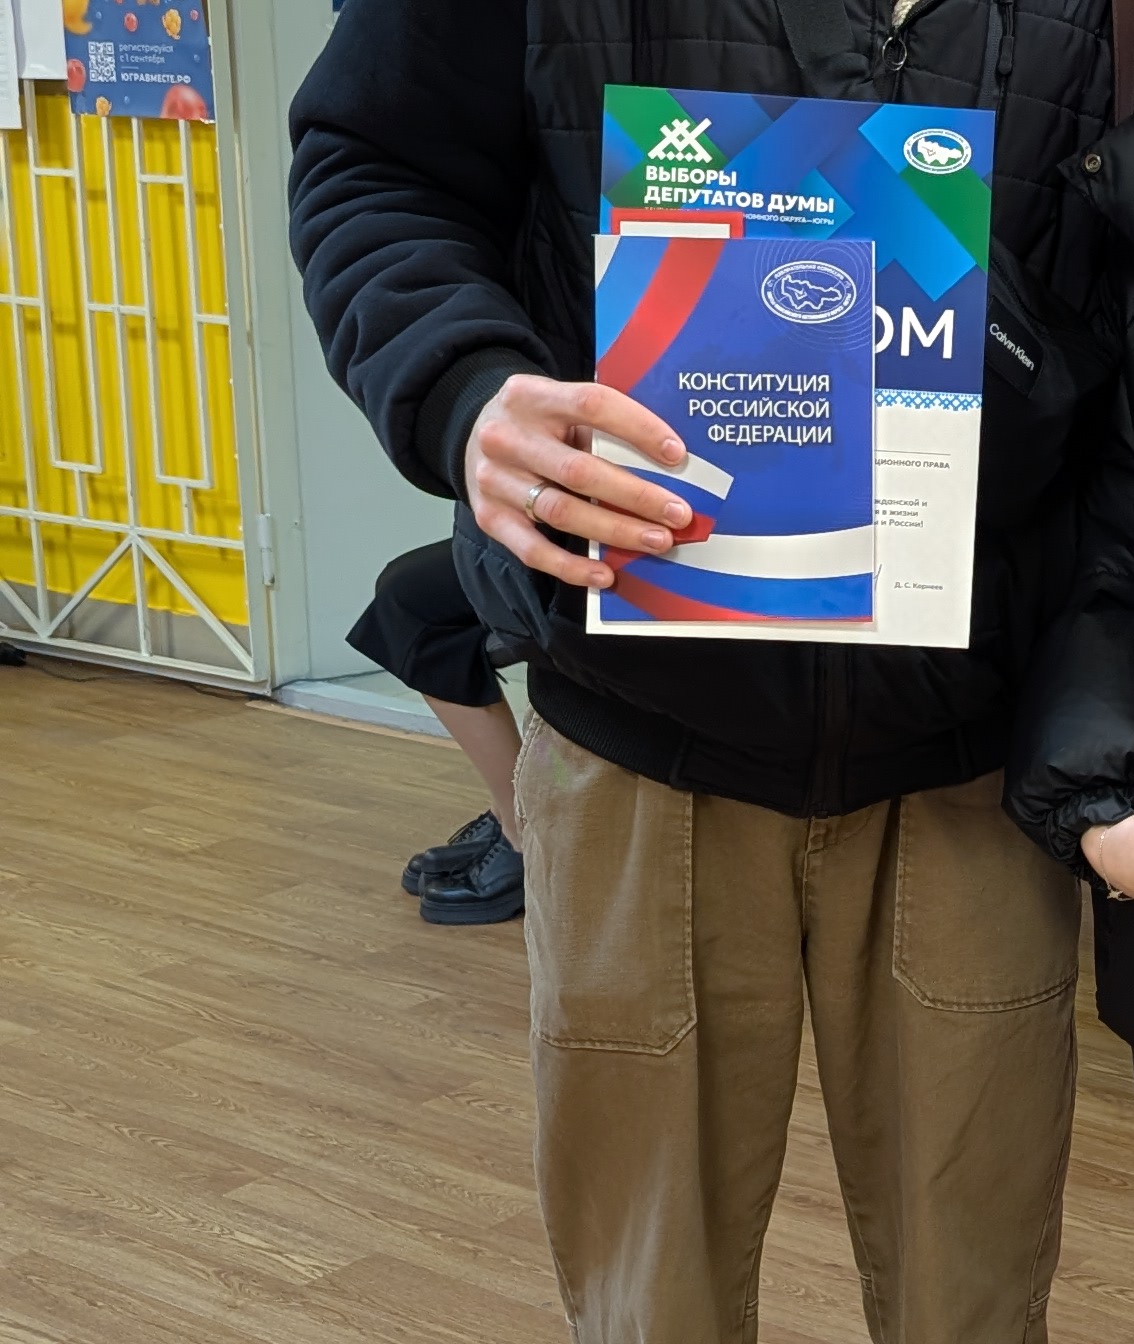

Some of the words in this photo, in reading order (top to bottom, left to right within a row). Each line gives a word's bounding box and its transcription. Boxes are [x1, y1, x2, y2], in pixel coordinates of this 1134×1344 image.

[121, 72, 192, 84] ЮГРАВМЕСТЕ.РФ
[645, 165, 737, 186] ВЫБОРЫ
[644, 186, 764, 208] ДЕПУТАТОВ
[767, 194, 835, 213] ДУМЫ
[990, 323, 1015, 353] Calvin
[1015, 346, 1035, 371] Klein
[678, 372, 830, 395] КОНСТИТУЦИЯ
[689, 397, 830, 419] РОССИЙСКОЙ
[708, 424, 832, 446] ФЕДЕРАЦИИ
[923, 461, 950, 469] ПРАВА
[889, 519, 923, 528] России!
